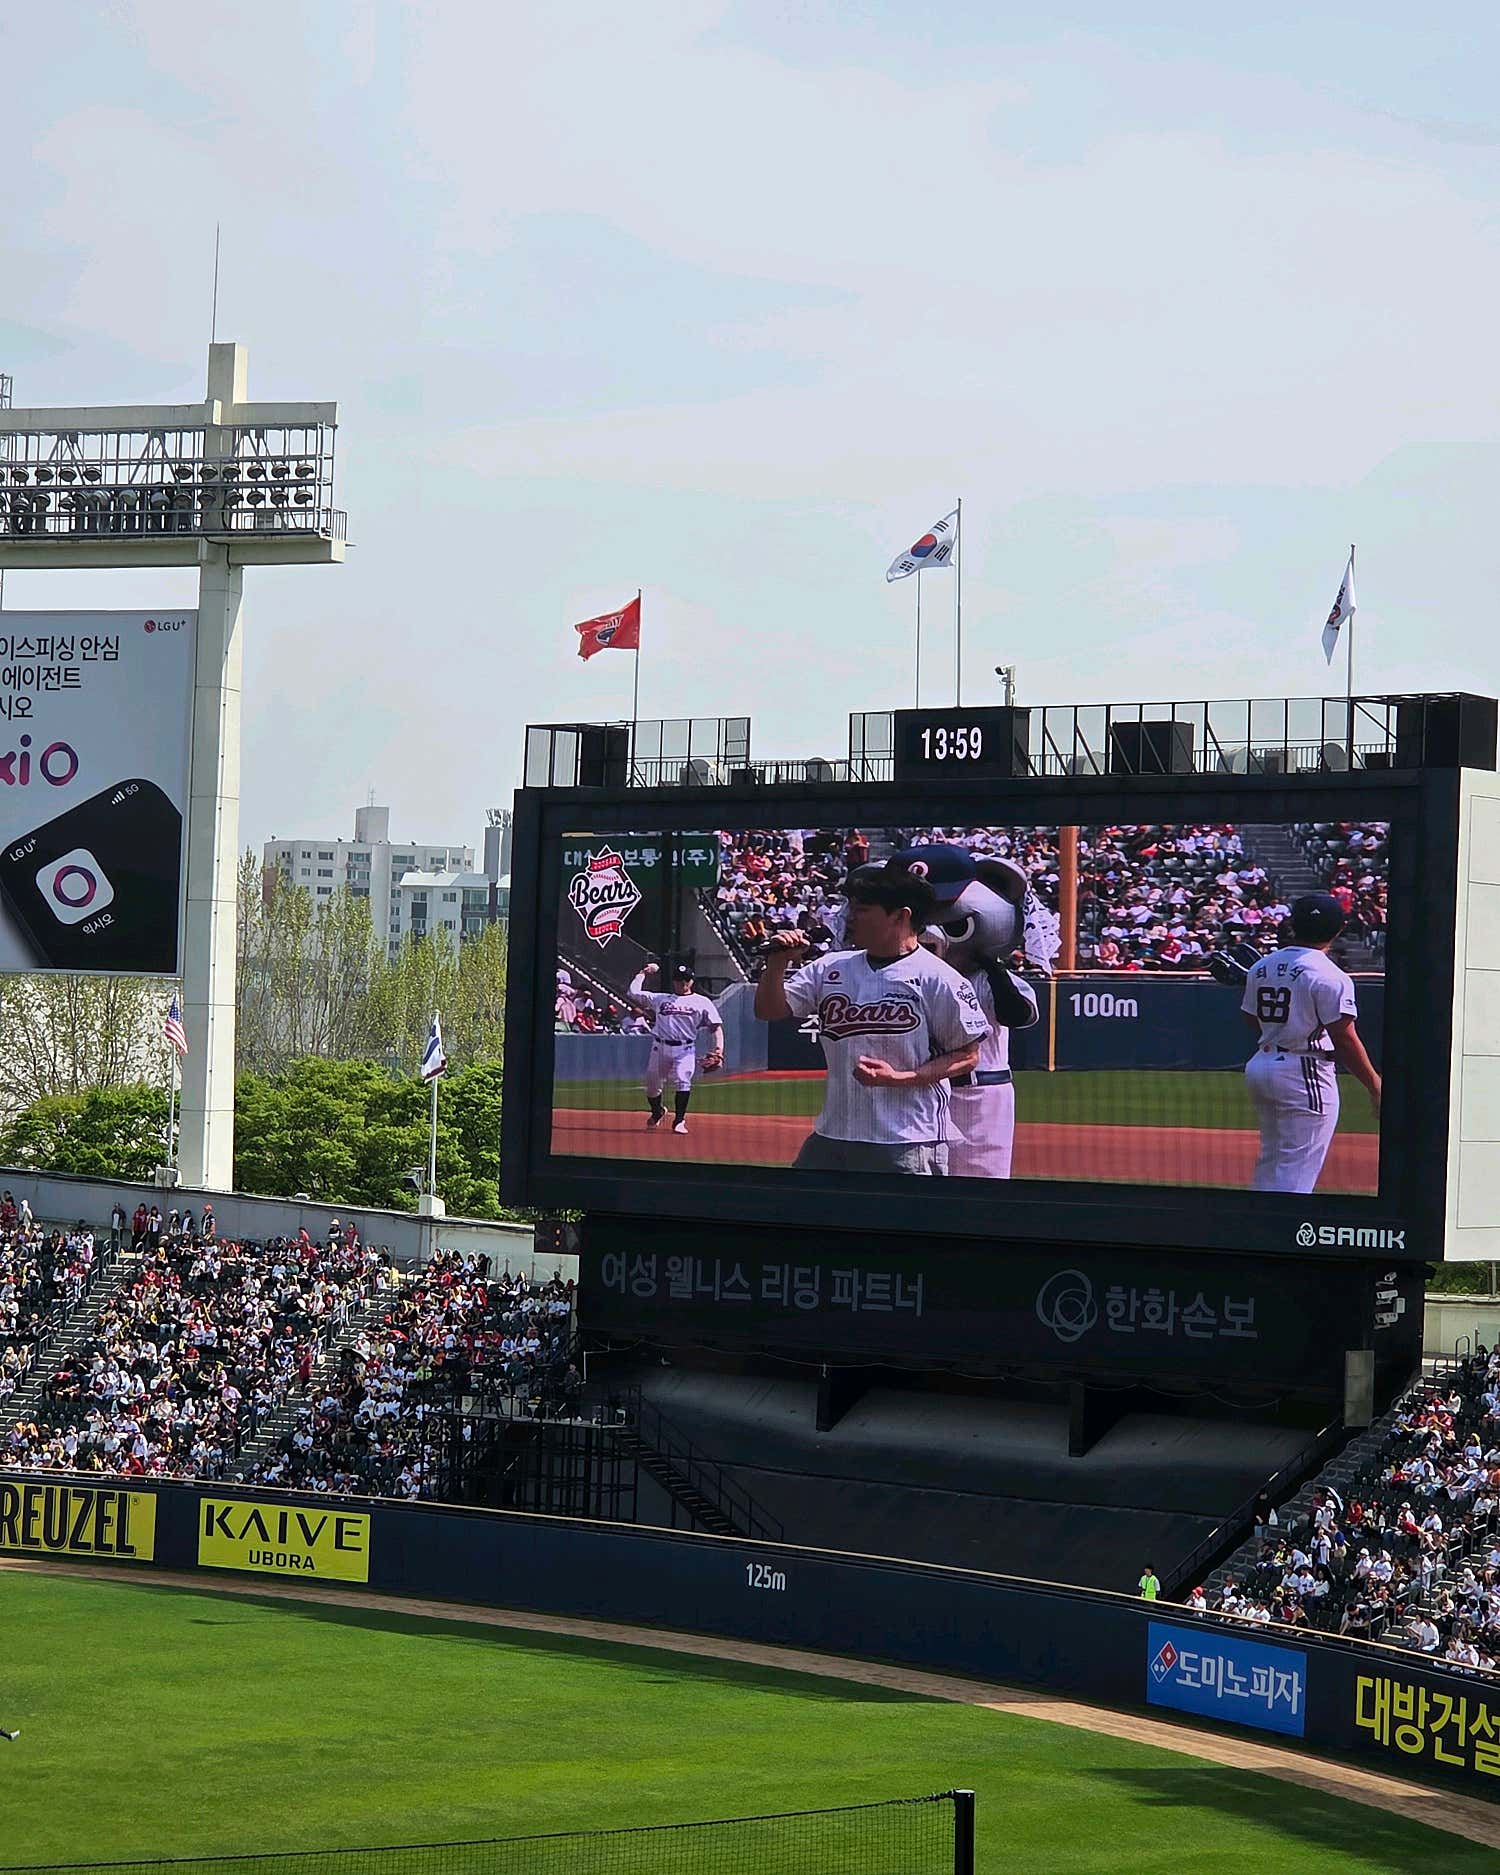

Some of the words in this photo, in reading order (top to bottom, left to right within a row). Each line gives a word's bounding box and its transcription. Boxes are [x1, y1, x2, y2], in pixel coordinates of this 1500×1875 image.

[80, 635, 120, 661] 안심
[2, 665, 82, 691] 에이전트
[921, 726, 982, 760] 13:59
[125, 782, 140, 797] 5G
[570, 872, 638, 909] Bears
[82, 912, 115, 936] 익시오
[819, 993, 921, 1034] Bears
[1070, 992, 1138, 1018] 100m
[1318, 1226, 1406, 1250] SAMIK
[601, 1251, 658, 1299] 여성
[665, 1255, 752, 1301] 웰니스
[760, 1263, 821, 1311] 리딩
[830, 1268, 924, 1317] 파트너
[1105, 1284, 1259, 1340] 한화손보
[205, 1503, 364, 1552] KAIVE
[248, 1549, 316, 1571] UBORA
[746, 1562, 786, 1591] 125m
[1176, 1650, 1302, 1715] 도미노피자
